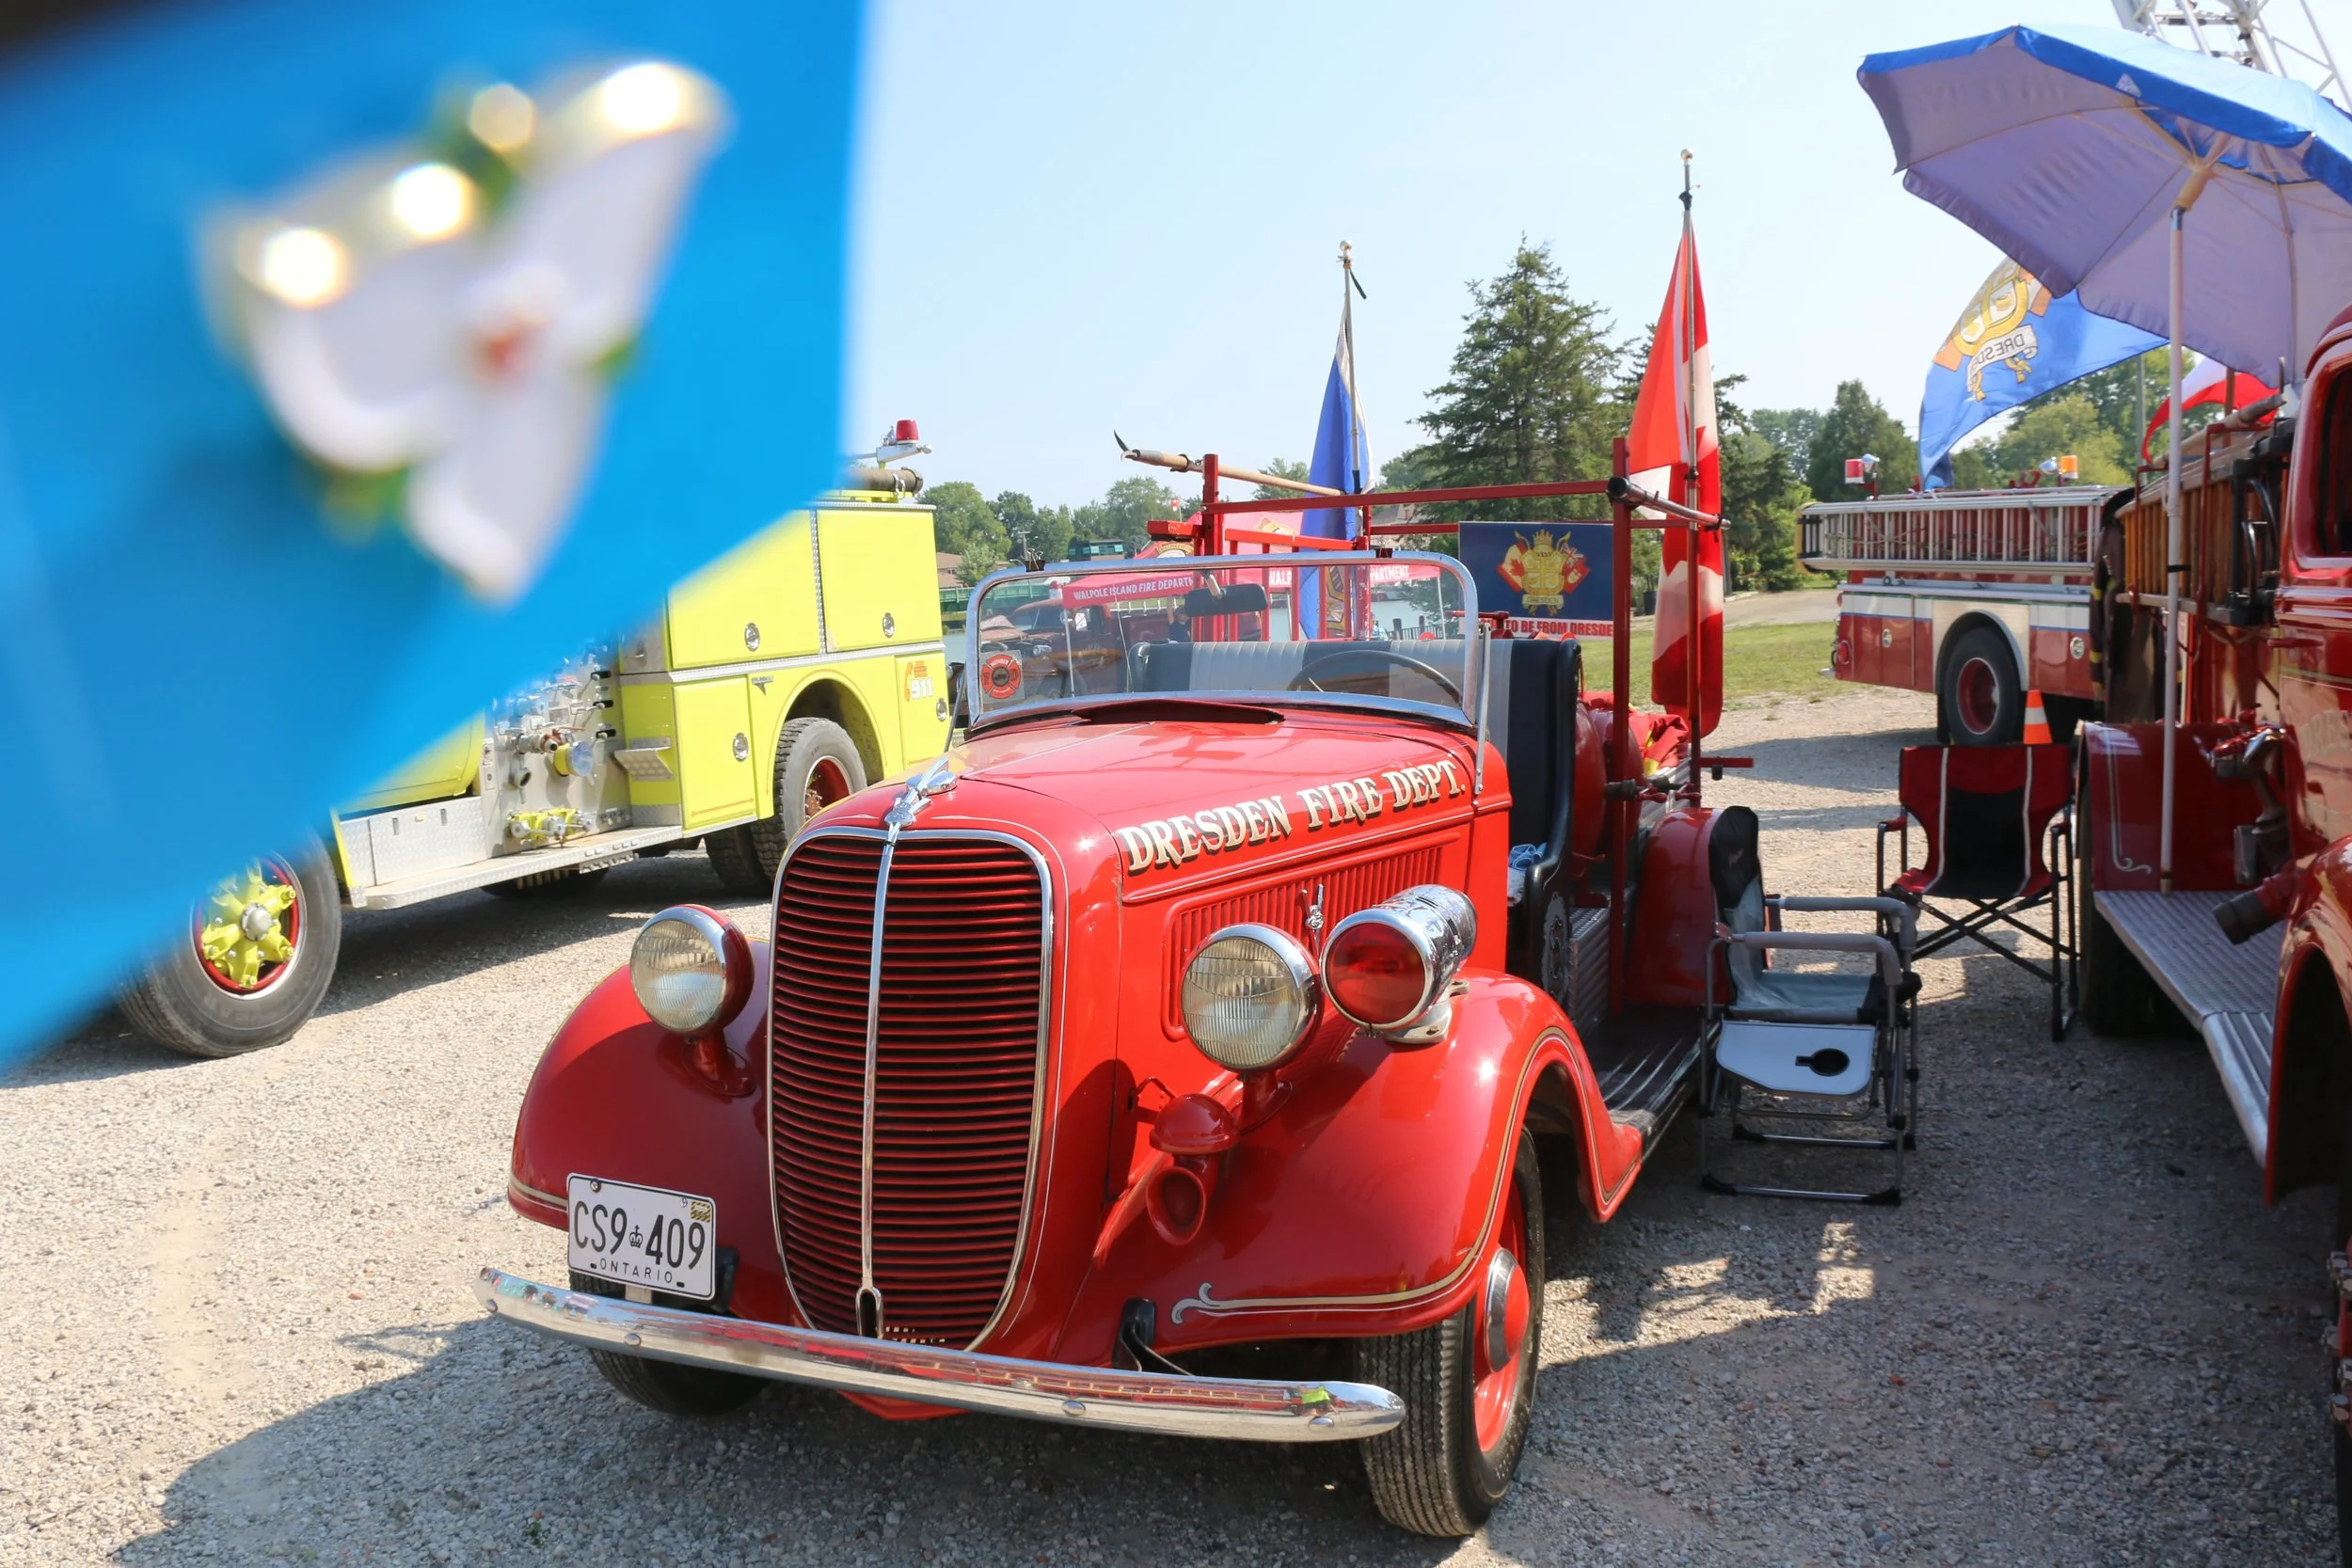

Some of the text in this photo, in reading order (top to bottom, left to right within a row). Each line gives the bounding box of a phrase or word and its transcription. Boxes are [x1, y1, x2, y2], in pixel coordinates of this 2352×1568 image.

[1073, 589, 1108, 601] WALPOLE
[1109, 584, 1137, 596] ISLAND
[1138, 581, 1157, 593] FIRE
[1505, 620, 1517, 632] TO
[1521, 621, 1534, 633] BE
[1536, 621, 1567, 635] FROM
[911, 677, 933, 700] 911
[1116, 759, 1467, 873] DRESDEN FIRE DEPT.
[600, 1258, 673, 1283] ONTARIO
